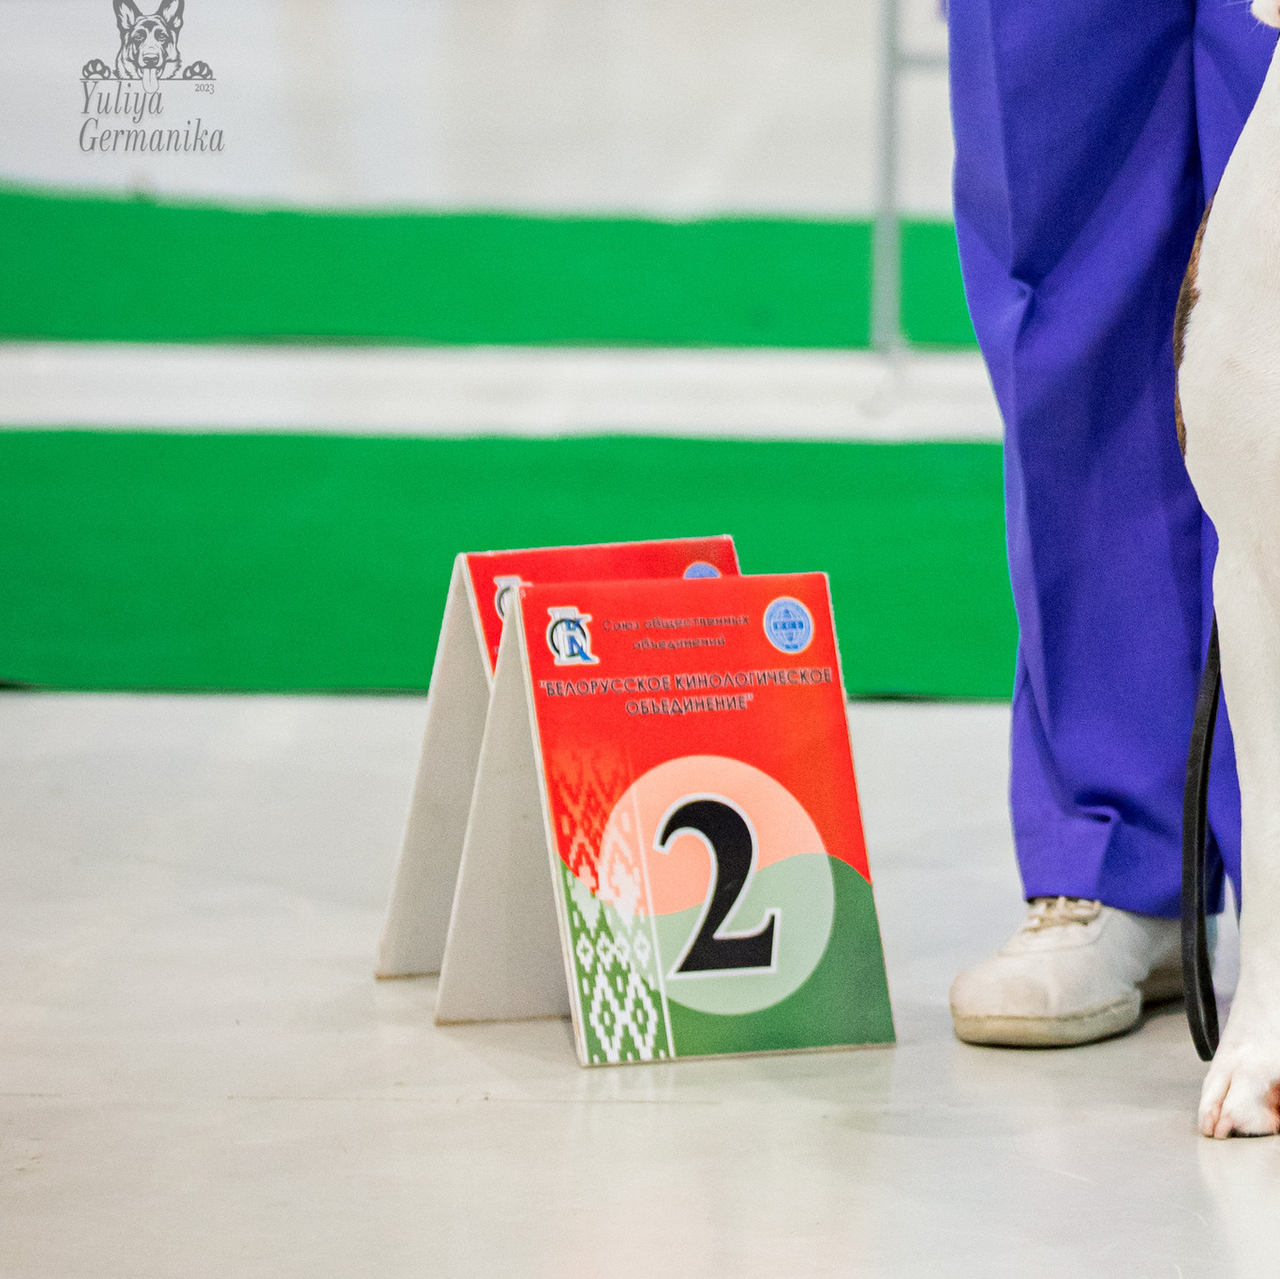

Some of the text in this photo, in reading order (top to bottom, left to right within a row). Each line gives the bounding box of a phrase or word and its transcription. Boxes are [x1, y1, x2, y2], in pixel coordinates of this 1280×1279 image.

[602, 619, 640, 631] Союз
[644, 615, 750, 632] общественных
[632, 635, 726, 651] объединений
[539, 667, 833, 698] "БЕЛОРУССКОЕ КИНОЛОГИЧЕСКОЕ
[625, 693, 754, 716] ОБЪЕДИНЕНИЕ"
[654, 792, 781, 980] 2
